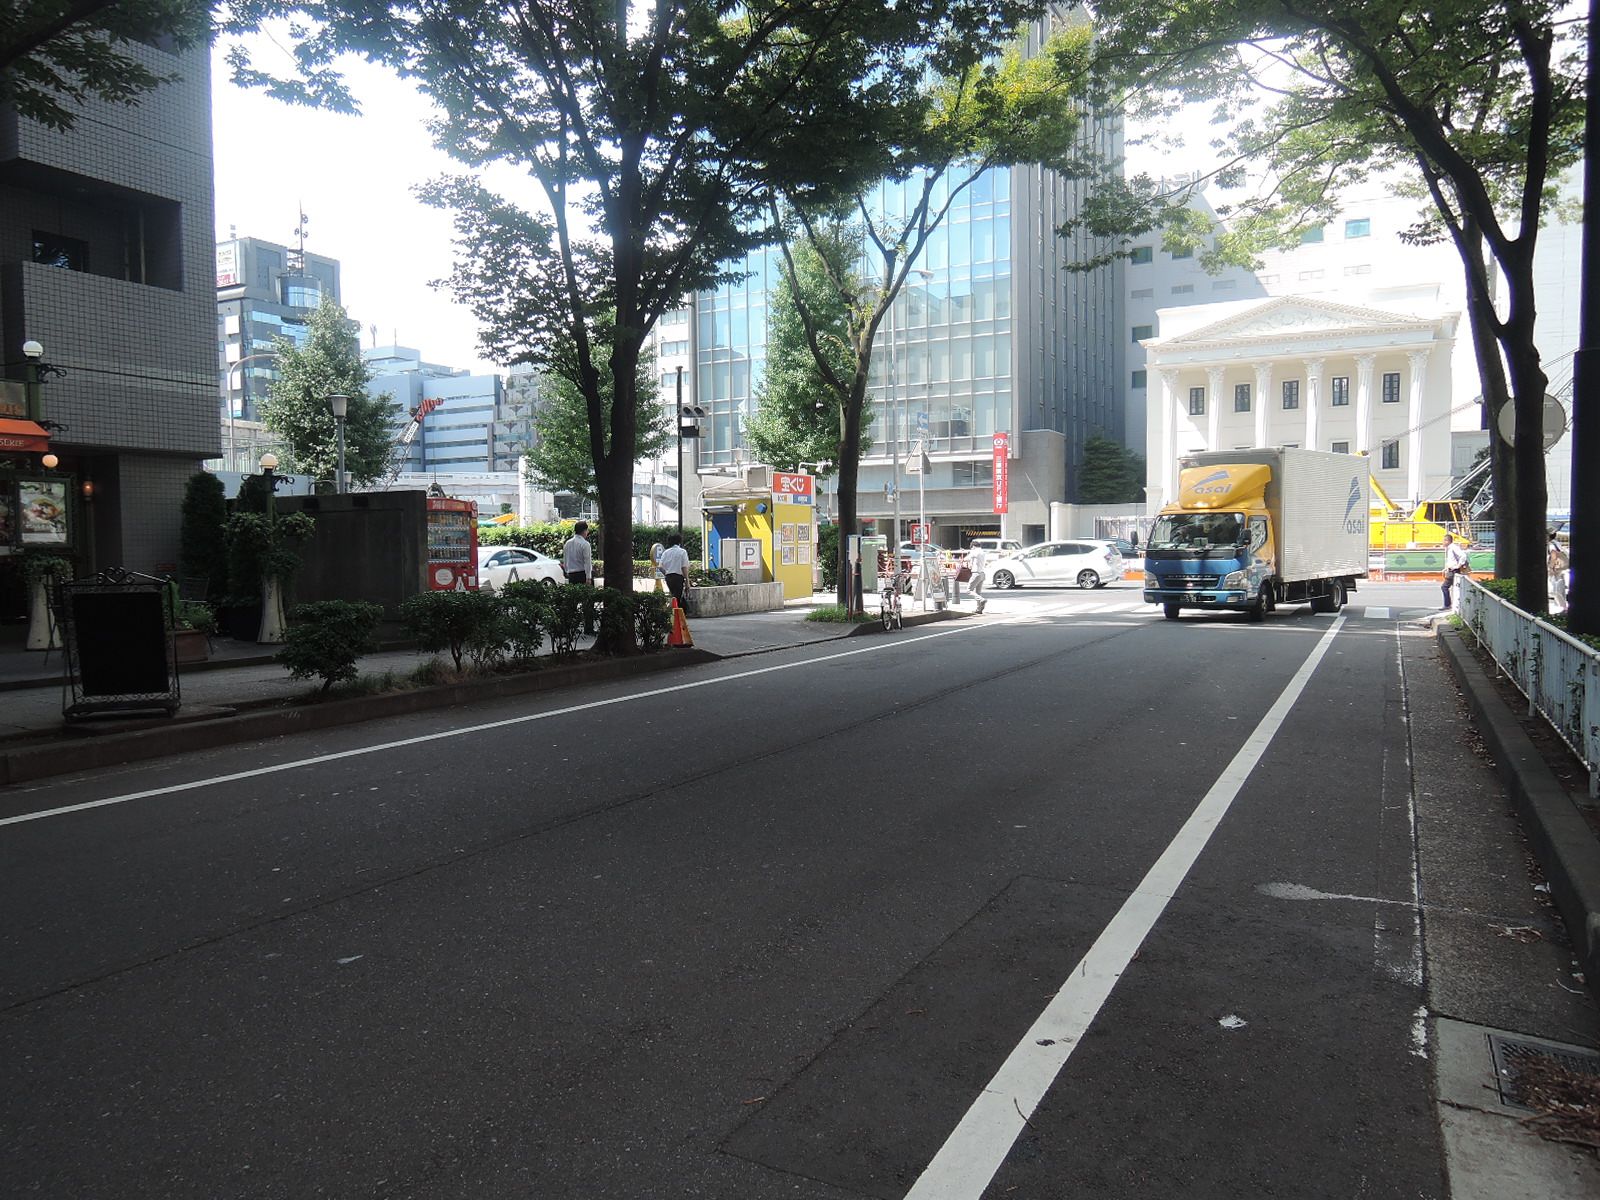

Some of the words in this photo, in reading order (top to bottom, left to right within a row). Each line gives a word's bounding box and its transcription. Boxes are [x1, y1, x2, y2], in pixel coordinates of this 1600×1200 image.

[780, 475, 805, 492] 宝くじ
[745, 547, 755, 560] P
